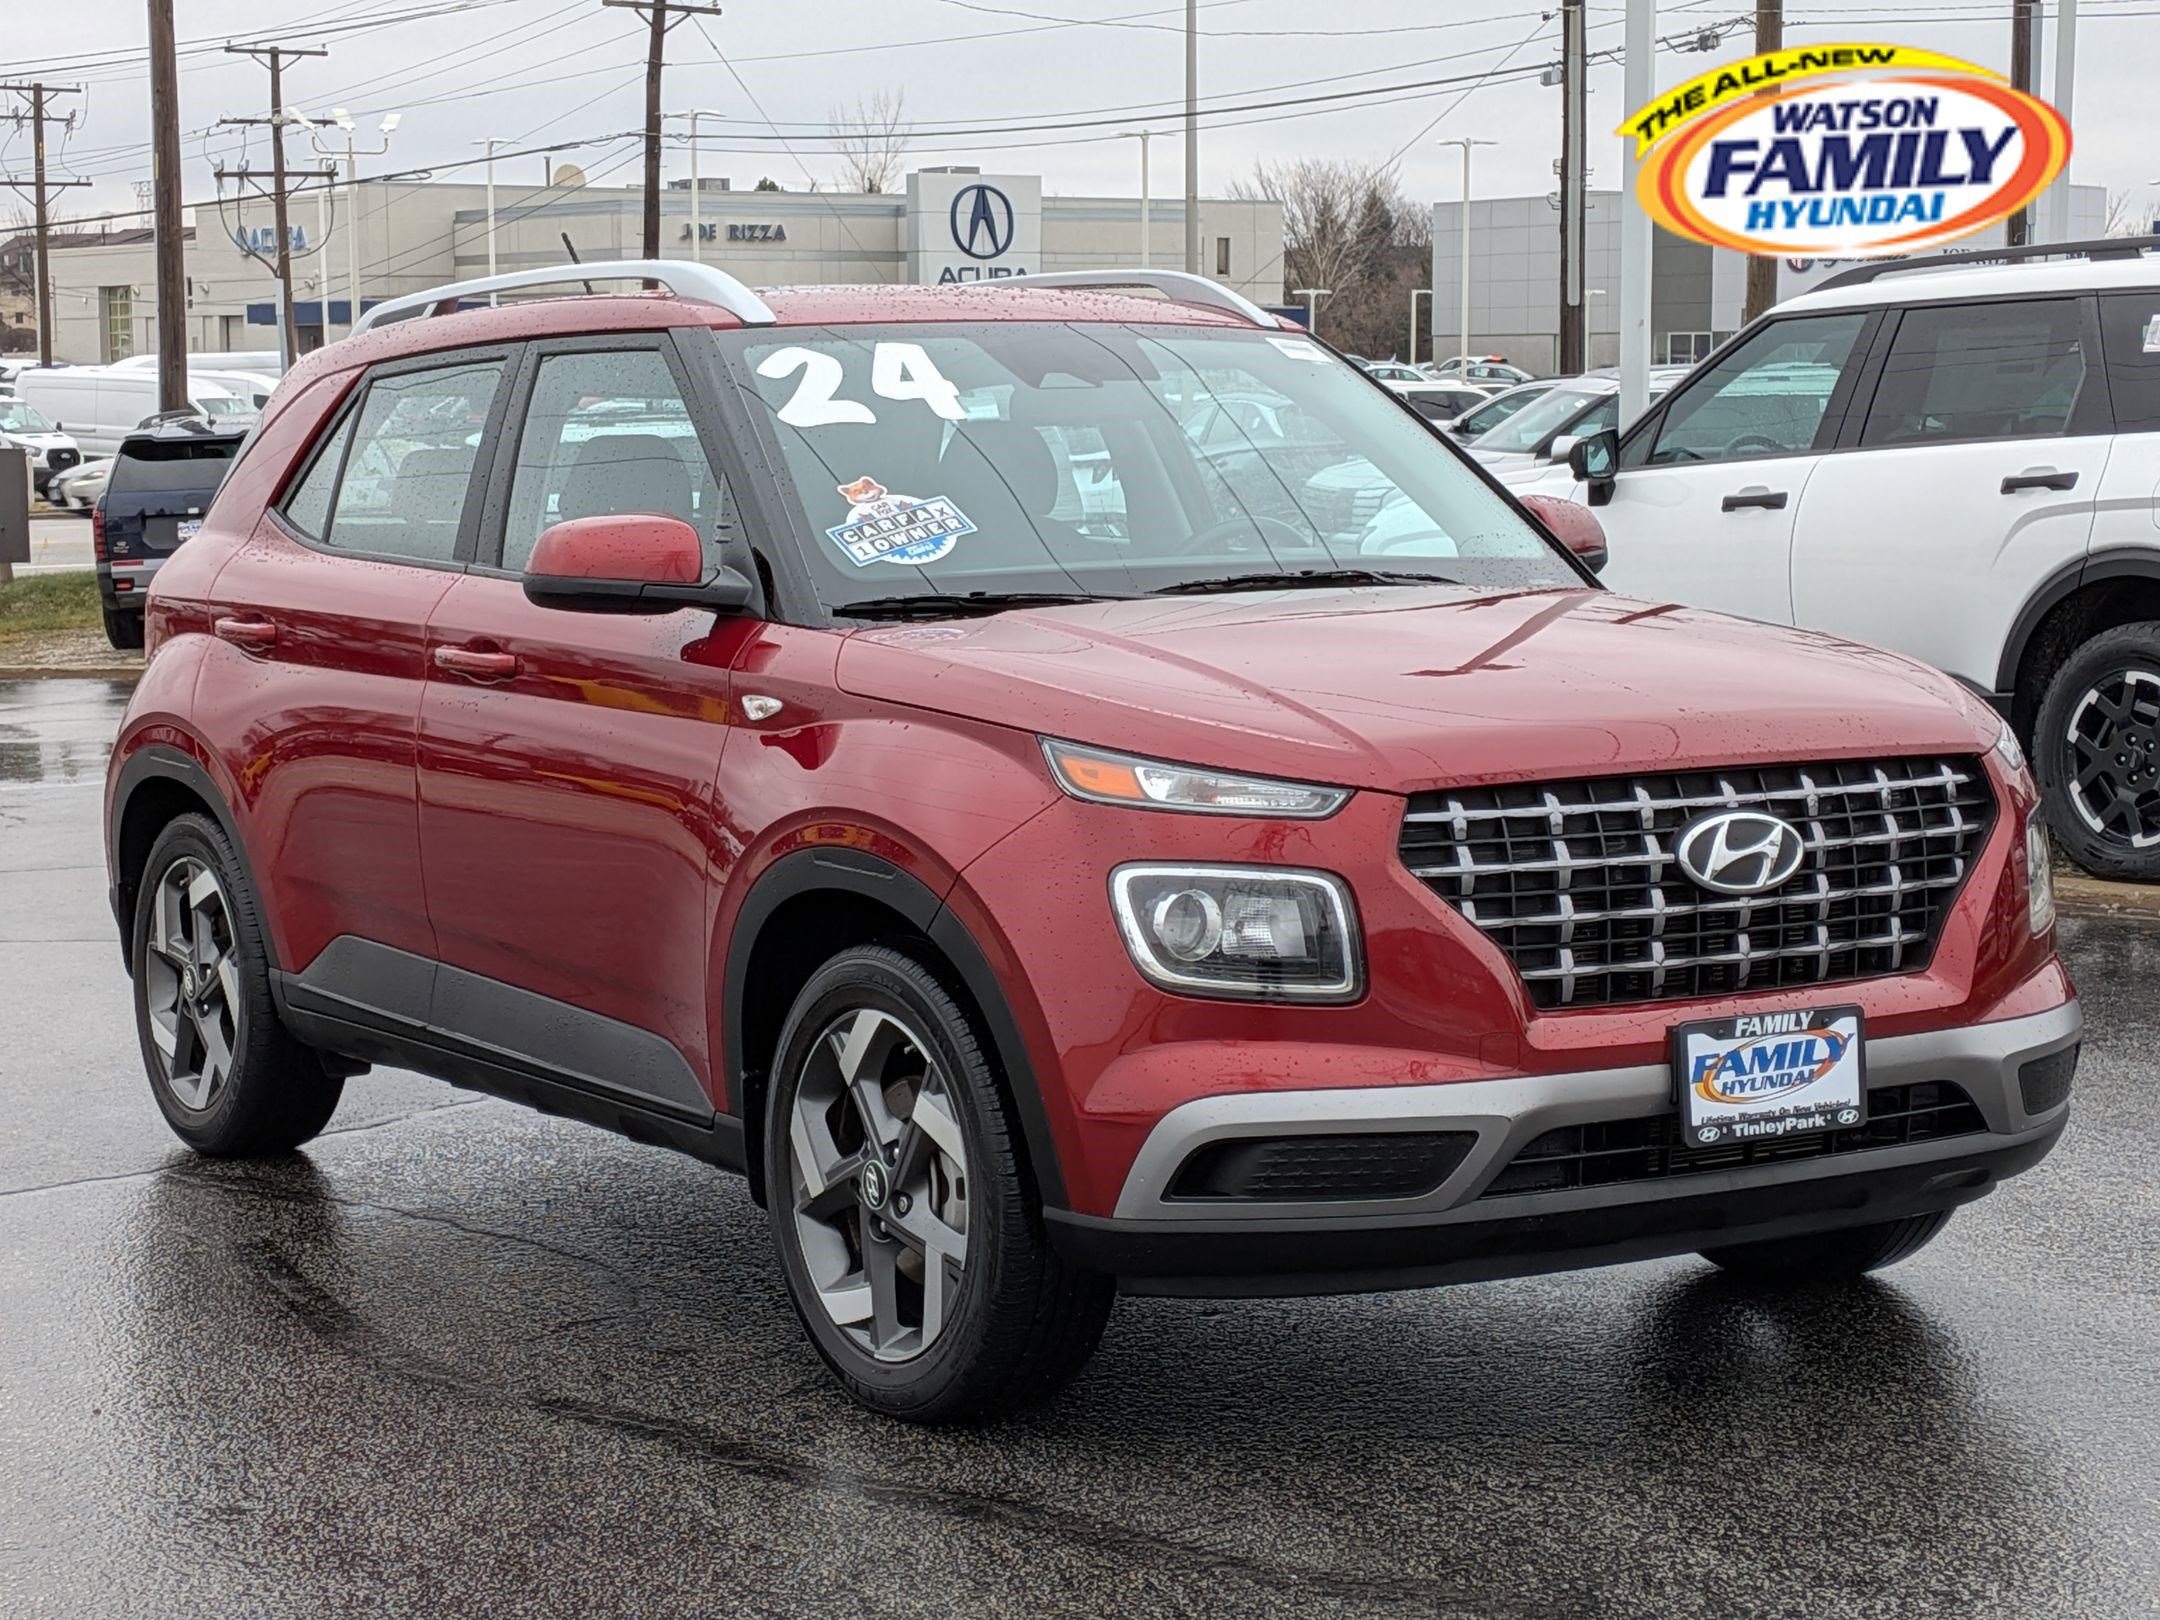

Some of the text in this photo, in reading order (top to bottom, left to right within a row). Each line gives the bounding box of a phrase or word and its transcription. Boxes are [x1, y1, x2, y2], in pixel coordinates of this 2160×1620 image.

[679, 223, 787, 241] JOE RIZZA
[756, 342, 968, 427] 24
[841, 506, 949, 542] CARFAX
[873, 518, 963, 551] OWNER
[1735, 1011, 1815, 1038] FAMILY
[1691, 1032, 1855, 1084] FAMILY
[1721, 1068, 1815, 1097] HYUNDAI
[1732, 1113, 1827, 1137] TinleyPark
